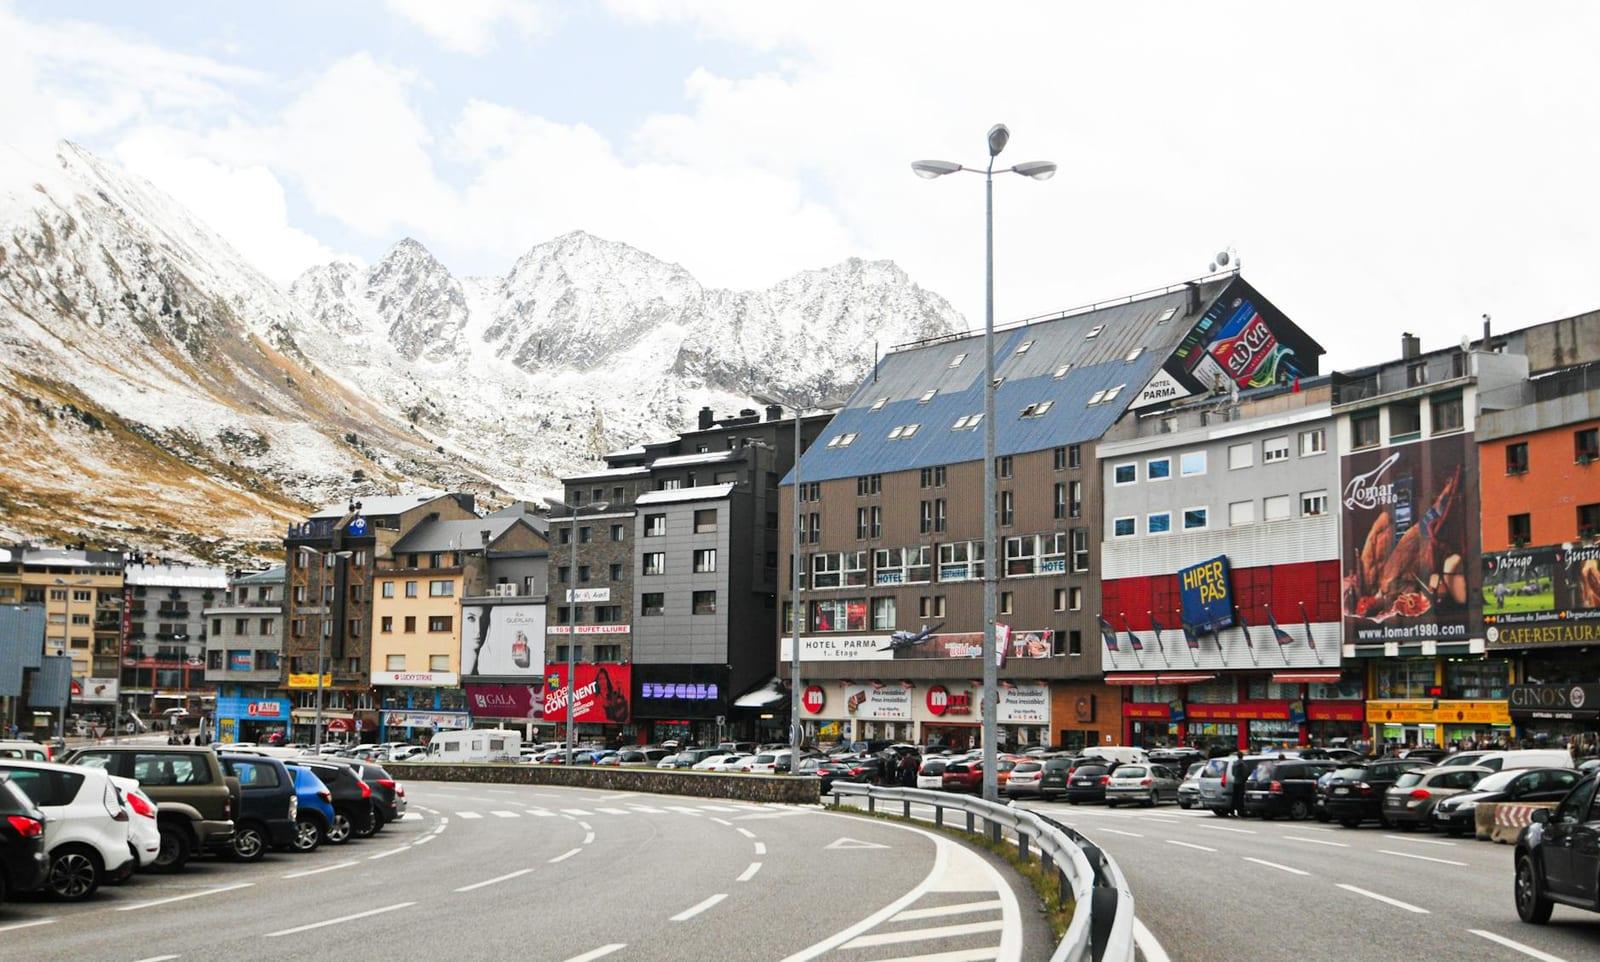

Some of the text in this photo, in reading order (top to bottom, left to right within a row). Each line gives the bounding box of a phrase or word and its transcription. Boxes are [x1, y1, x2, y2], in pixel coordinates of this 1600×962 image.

[1149, 380, 1171, 388] HOTEL
[1143, 387, 1177, 400] PARMA
[1377, 494, 1398, 505] 1980
[877, 573, 902, 583] HOTEL
[1183, 561, 1223, 591] HIPER
[1200, 578, 1226, 604] PAS
[1358, 623, 1465, 640] www.lomar1980.com
[806, 640, 877, 649] HOTEL PARMA
[486, 695, 516, 705] GALA
[544, 681, 597, 714] CONTNENT
[1511, 687, 1566, 706] GINO'S
